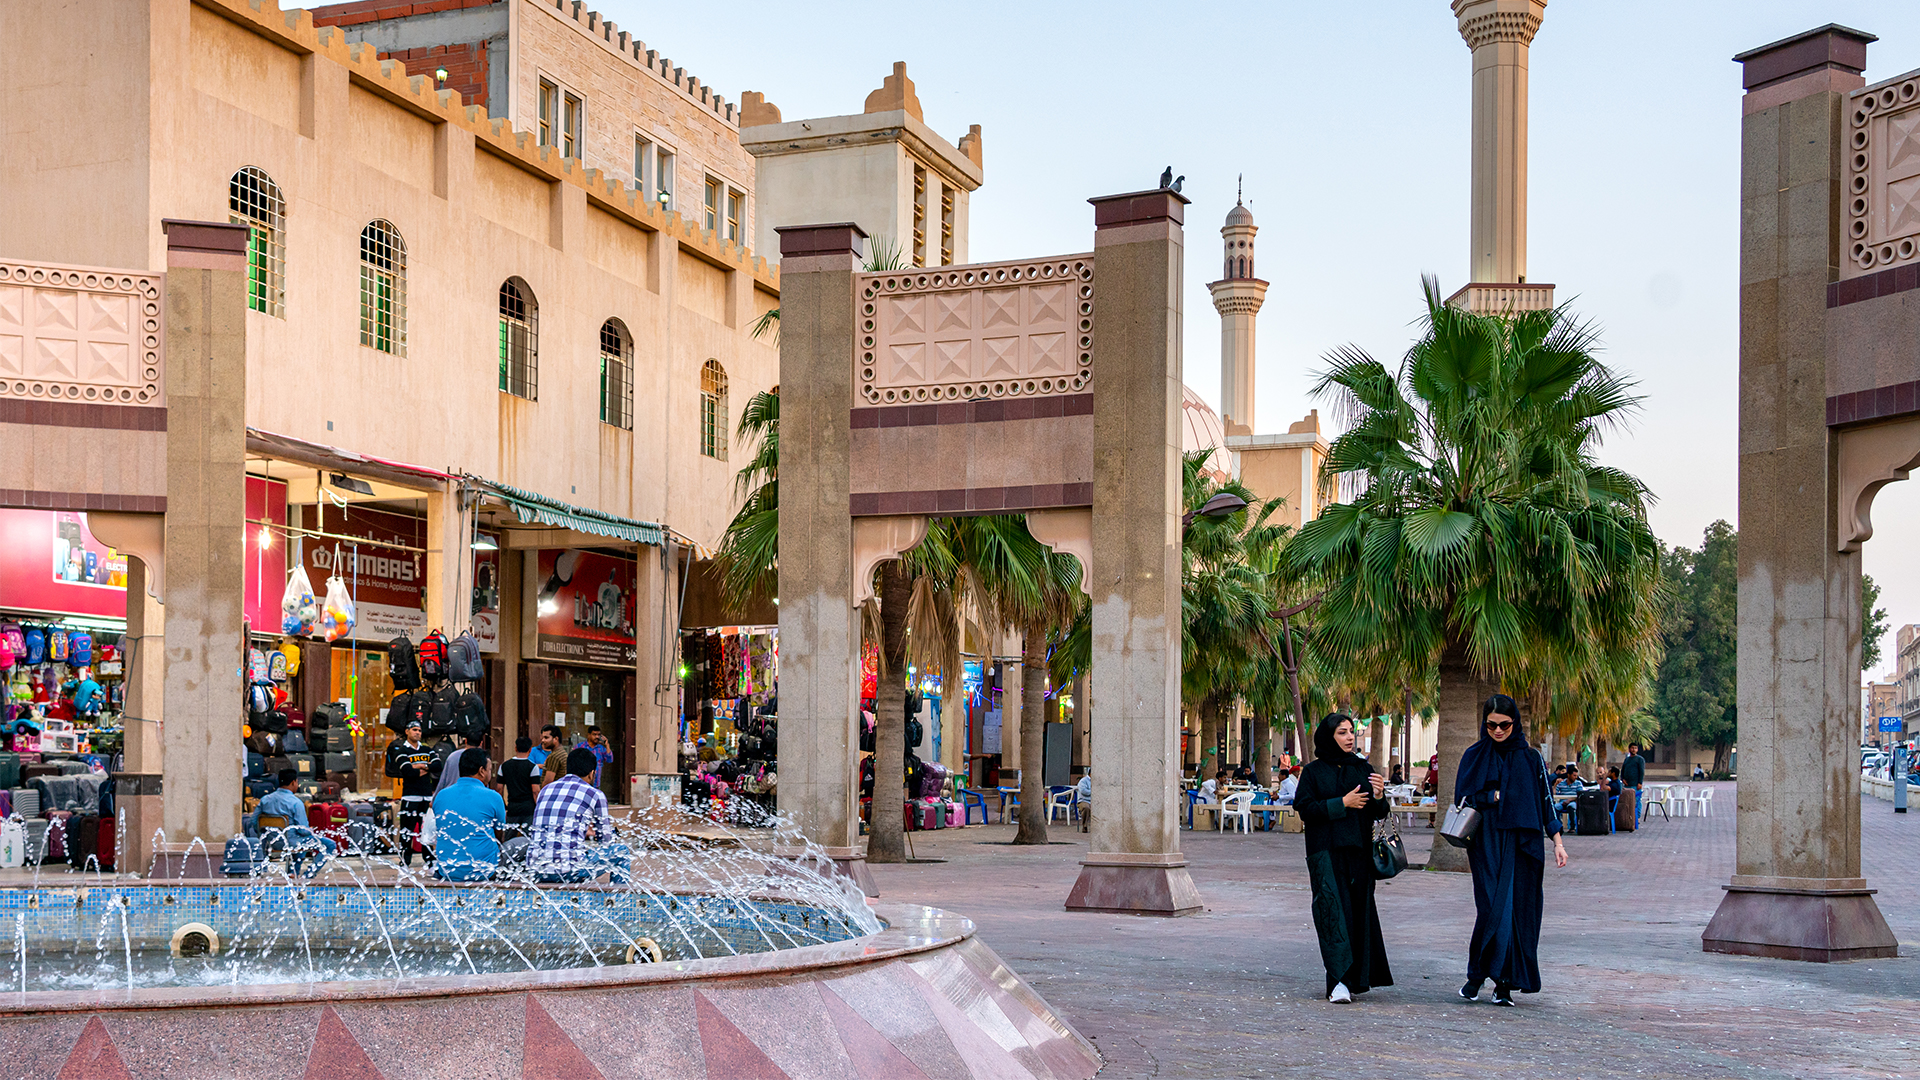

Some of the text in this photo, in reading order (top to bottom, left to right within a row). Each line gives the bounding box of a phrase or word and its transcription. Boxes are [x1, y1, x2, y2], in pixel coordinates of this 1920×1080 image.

[333, 550, 413, 581] TAMBAS
[366, 578, 371, 587] &
[371, 579, 388, 589] Home
[389, 582, 418, 593] Appliances
[556, 643, 584, 656] ELECTRONICS
